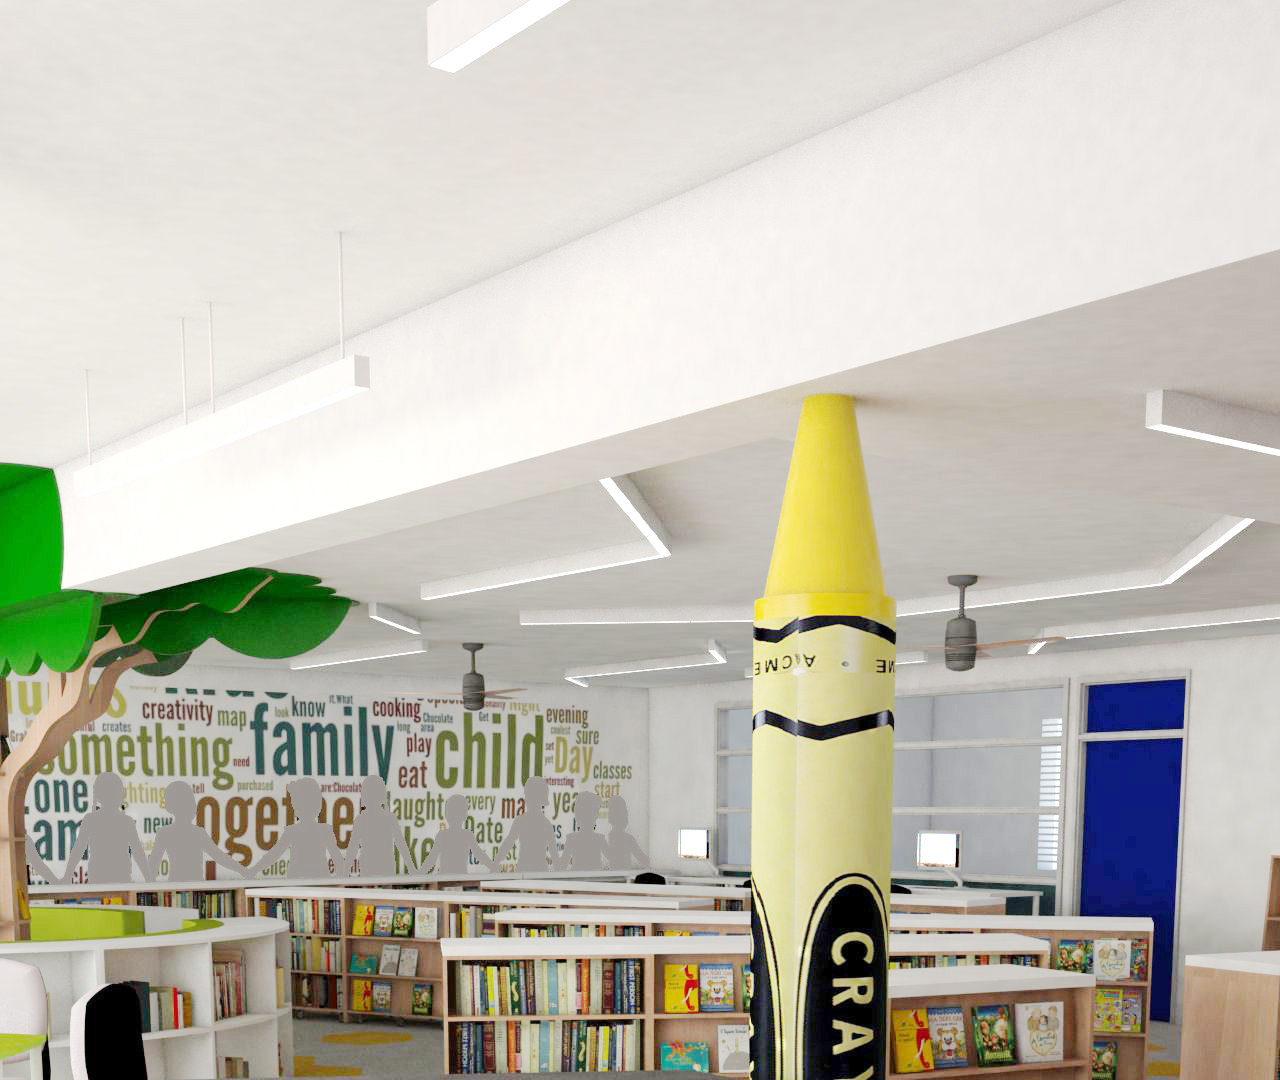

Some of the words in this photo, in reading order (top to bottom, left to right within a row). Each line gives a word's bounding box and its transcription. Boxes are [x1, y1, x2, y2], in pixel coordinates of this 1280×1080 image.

[142, 698, 213, 727] creativity
[291, 695, 326, 717] know
[372, 697, 422, 723] cooking
[478, 711, 490, 722] Get
[546, 704, 589, 729] evening
[102, 721, 132, 733] creates
[217, 709, 247, 732] map
[396, 720, 411, 734] long
[423, 711, 454, 724] Chocolate
[250, 701, 395, 786] family
[406, 732, 433, 758] play
[576, 729, 600, 745] sure
[435, 711, 545, 789] child
[554, 735, 594, 784] Day
[233, 756, 251, 768] need
[593, 760, 633, 780] classes
[398, 761, 428, 789] eat
[320, 782, 362, 794] are:Chocolat
